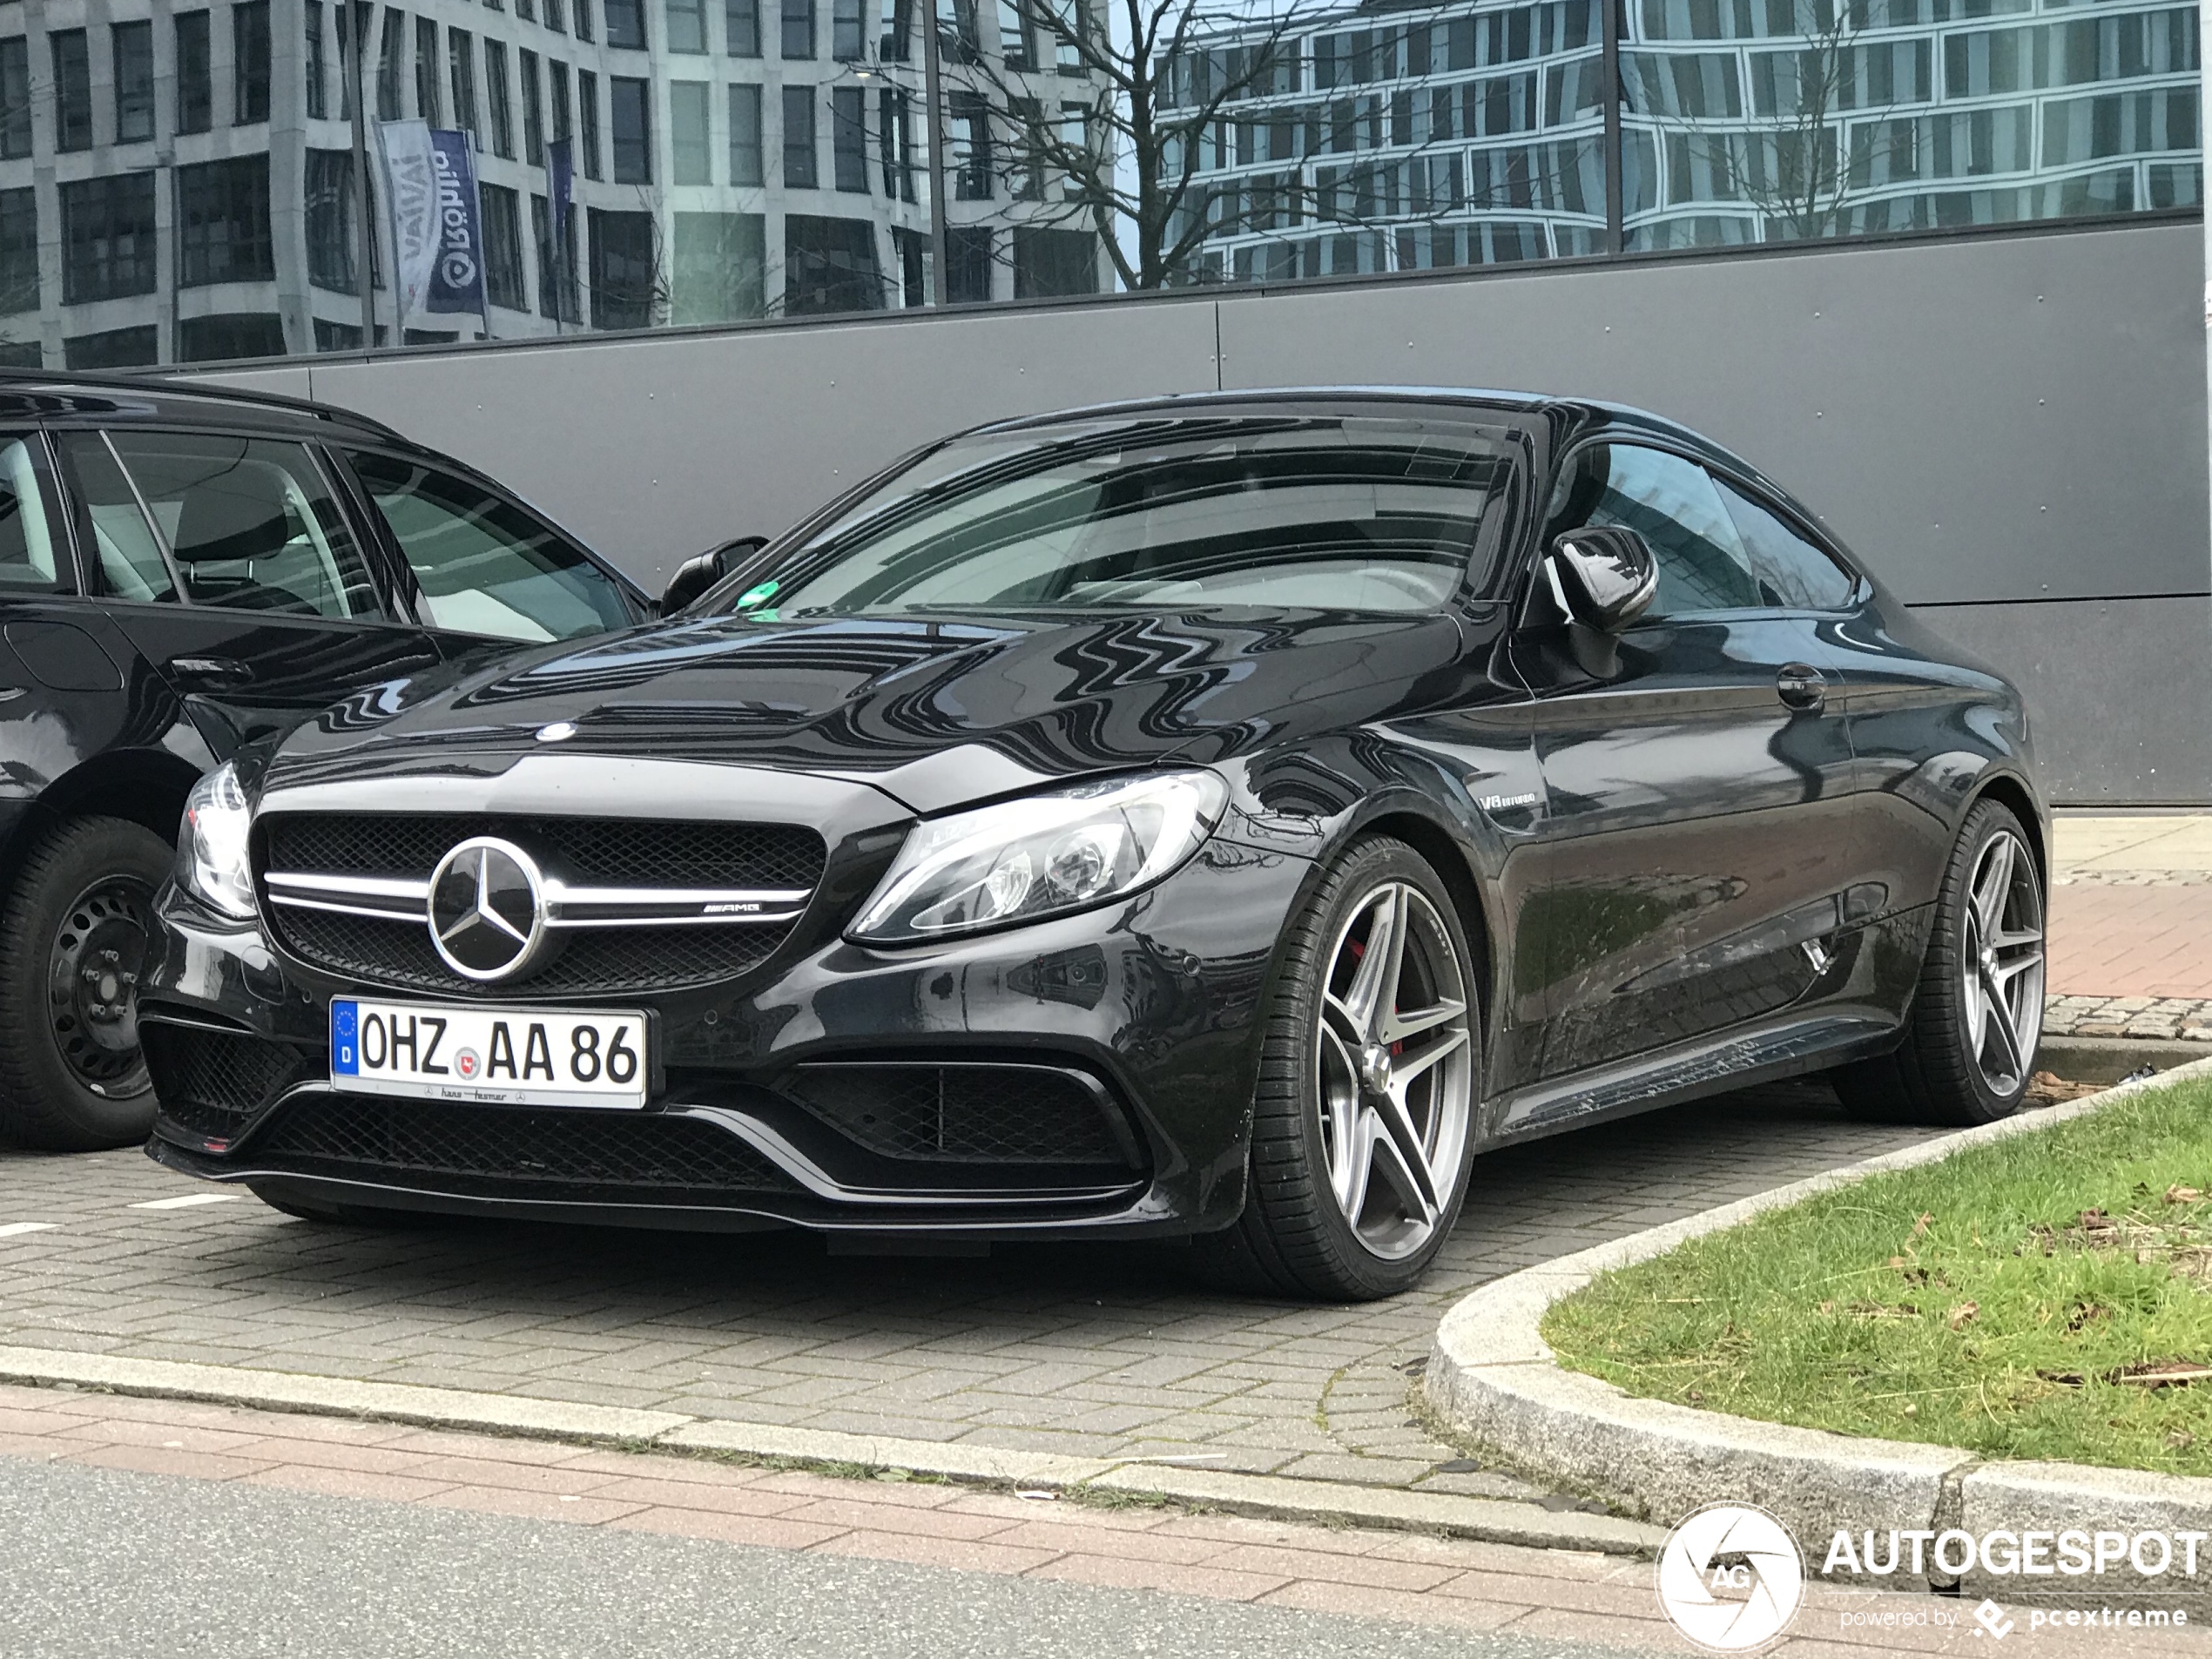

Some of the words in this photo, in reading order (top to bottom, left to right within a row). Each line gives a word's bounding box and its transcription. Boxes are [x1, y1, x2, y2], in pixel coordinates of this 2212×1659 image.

[1479, 794, 1502, 811] V8
[341, 1046, 351, 1064] D
[361, 1012, 449, 1075] OHZ
[486, 1021, 555, 1082] AA
[570, 1024, 637, 1084] 86
